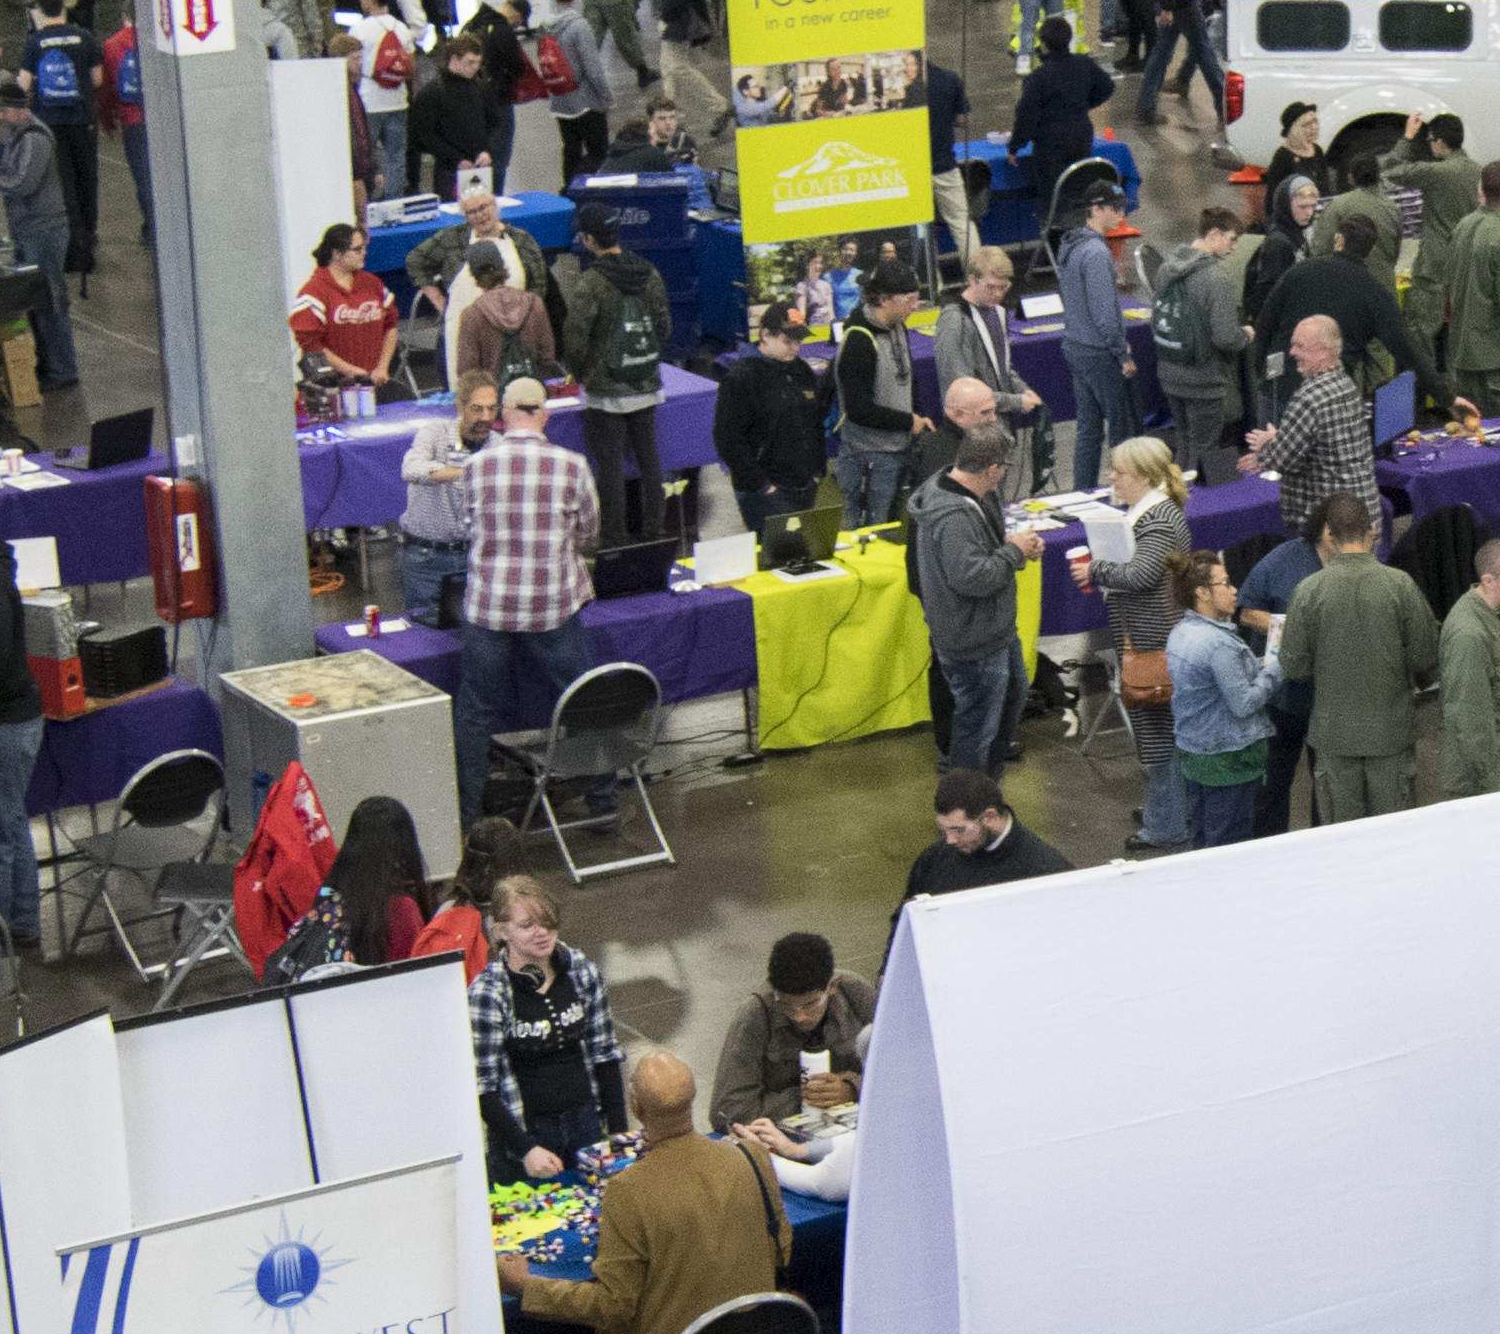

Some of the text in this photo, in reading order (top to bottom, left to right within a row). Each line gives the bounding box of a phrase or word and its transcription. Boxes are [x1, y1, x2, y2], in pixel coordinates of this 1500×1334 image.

[765, 17, 779, 31] in
[785, 15, 795, 29] a
[801, 10, 834, 27] new
[773, 175, 851, 201] CLOVER
[856, 167, 908, 188] PARK
